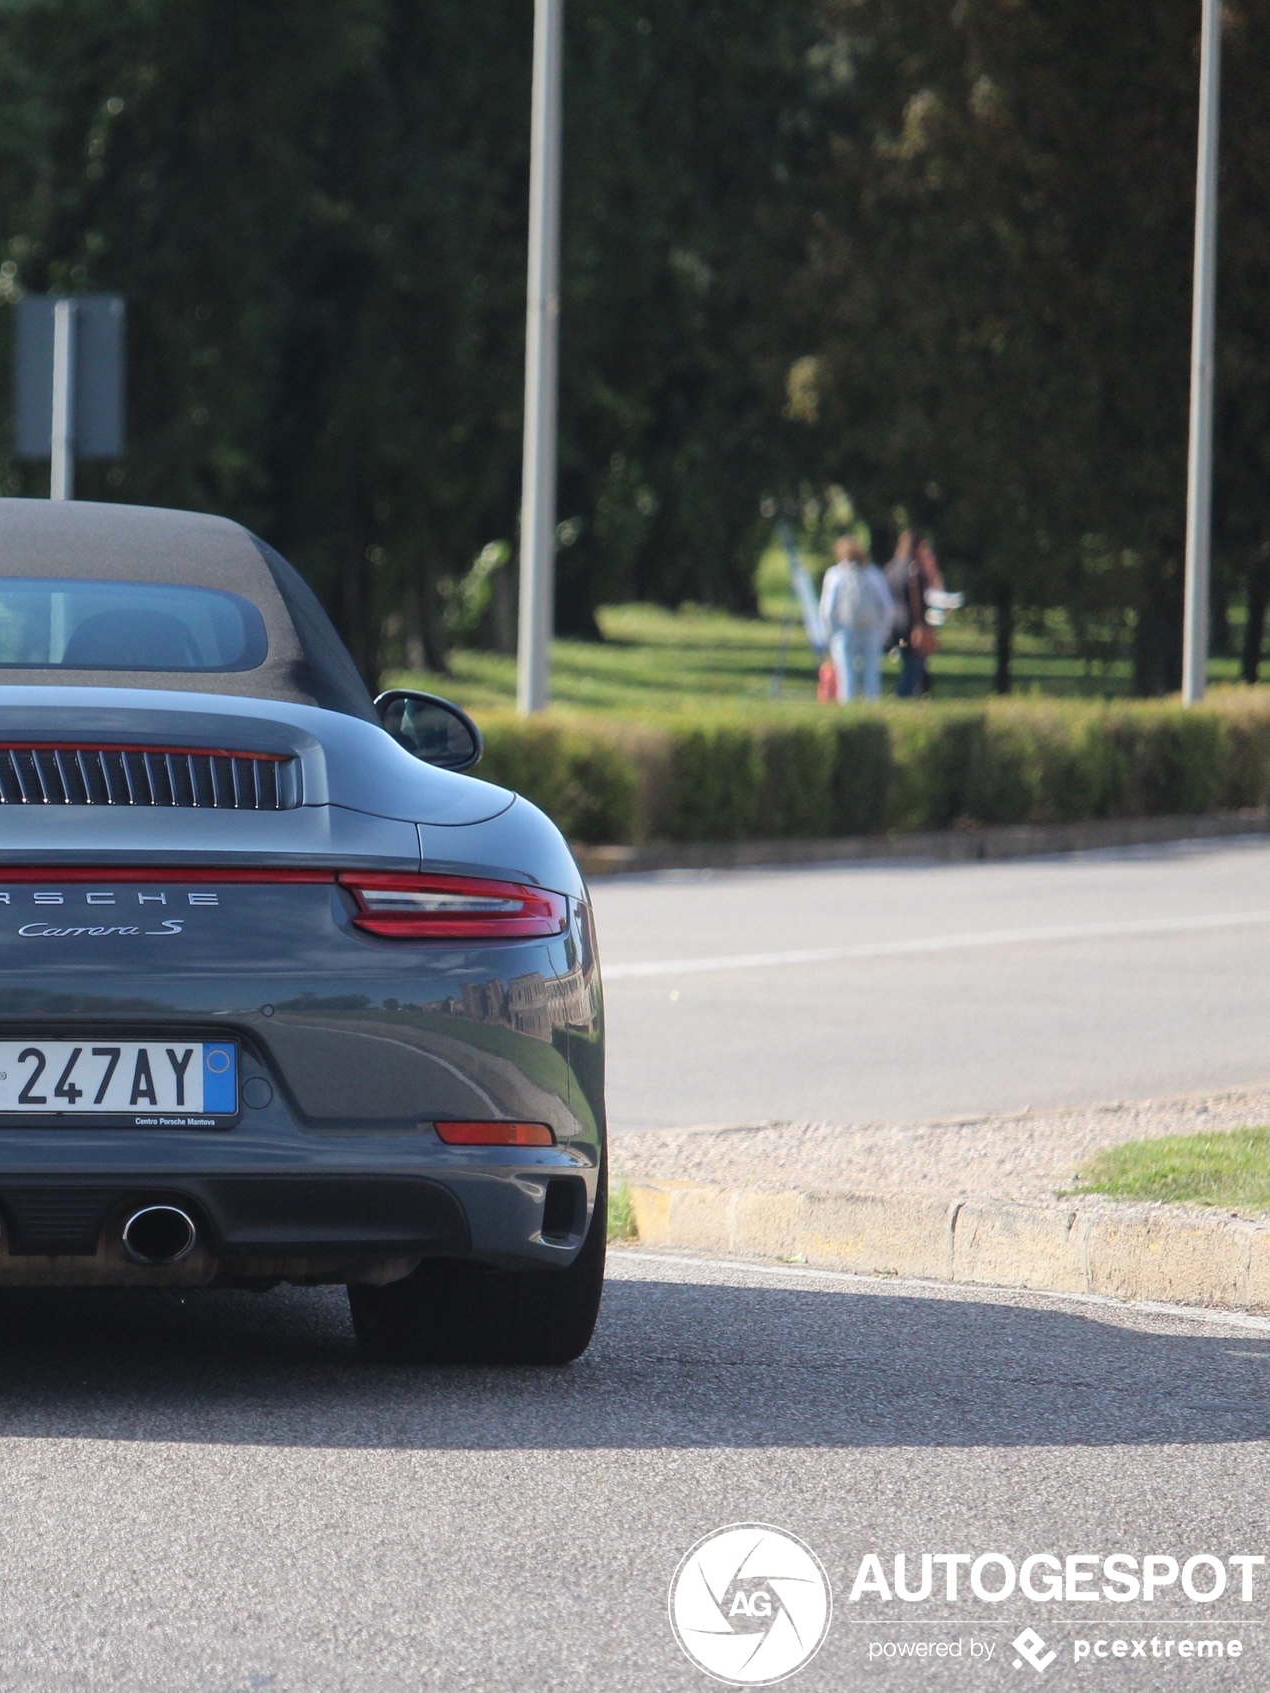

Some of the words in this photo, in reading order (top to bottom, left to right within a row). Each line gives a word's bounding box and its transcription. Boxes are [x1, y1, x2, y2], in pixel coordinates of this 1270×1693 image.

[18, 922, 139, 938] Carrera
[146, 919, 185, 935] S
[17, 1046, 194, 1106] 247AY
[135, 1117, 158, 1126] Centro
[159, 1117, 186, 1126] Porsche
[187, 1117, 215, 1126] Mantova
